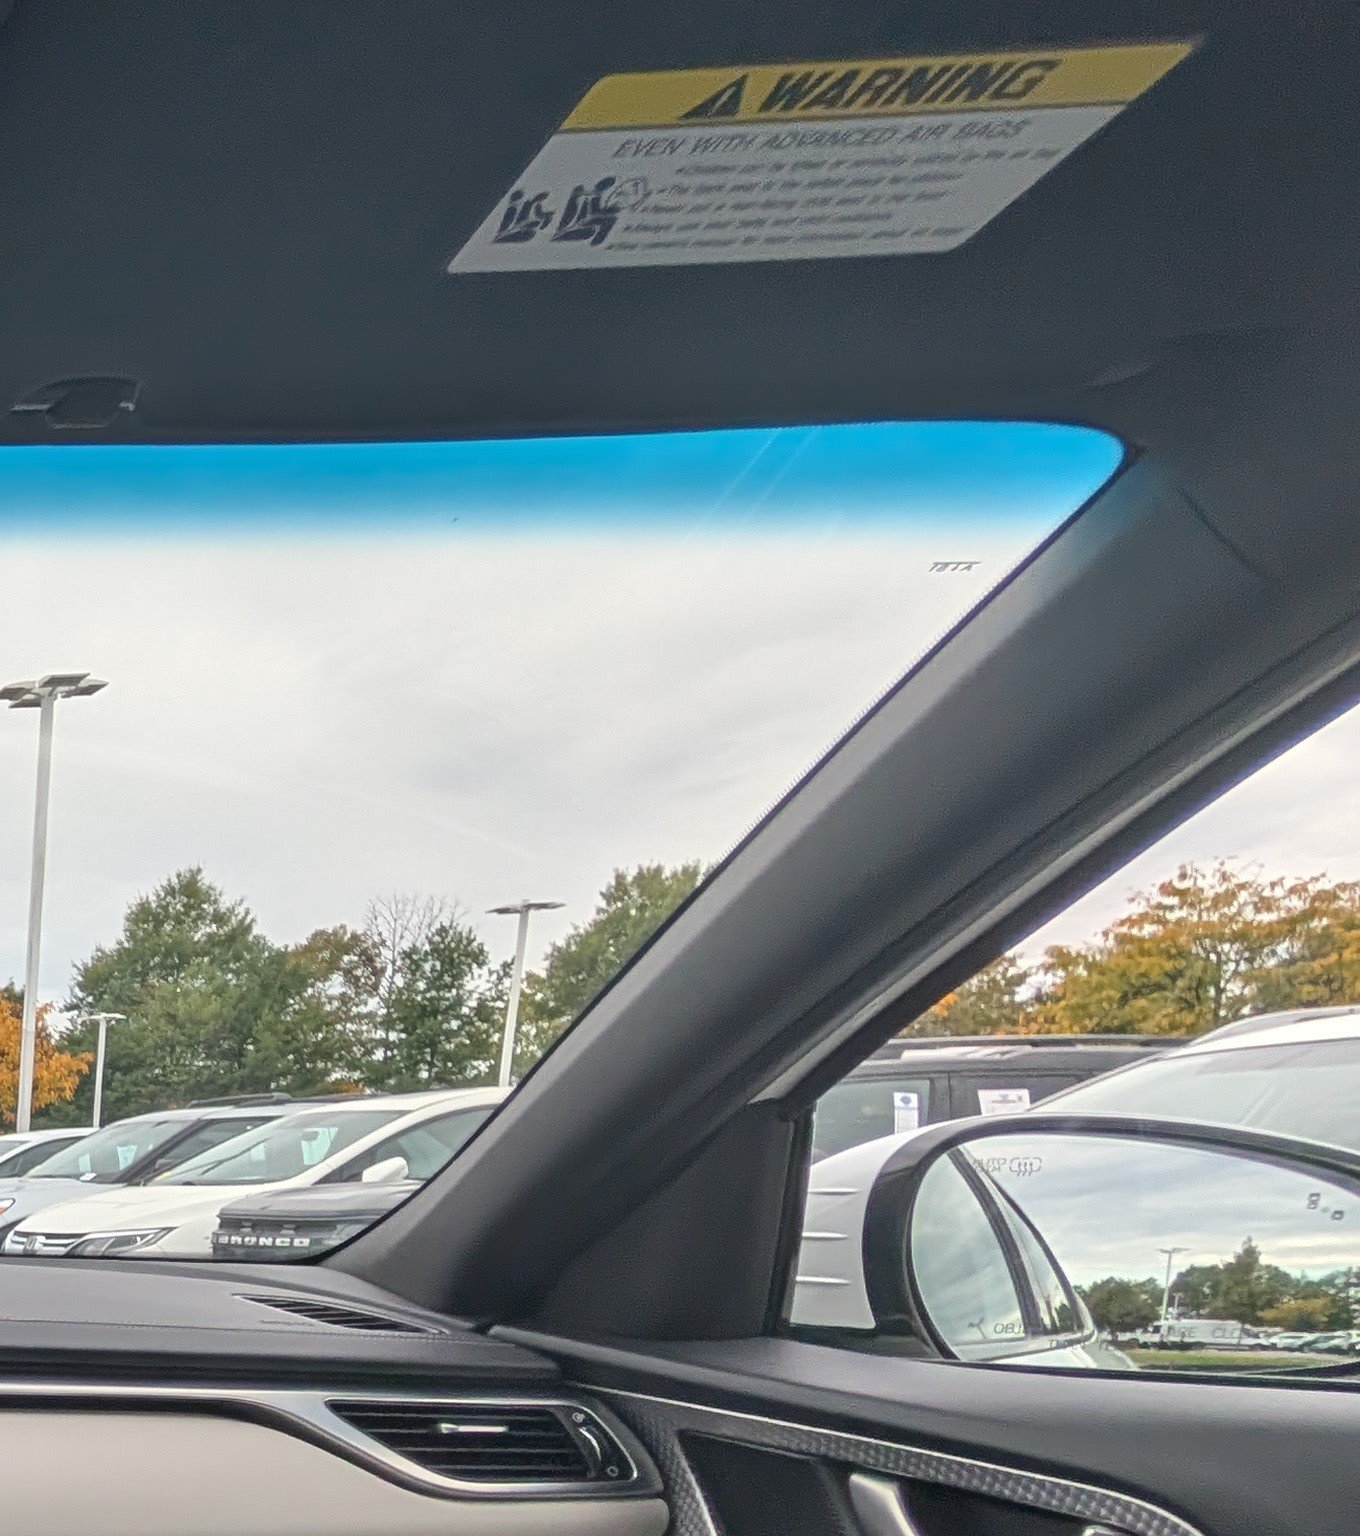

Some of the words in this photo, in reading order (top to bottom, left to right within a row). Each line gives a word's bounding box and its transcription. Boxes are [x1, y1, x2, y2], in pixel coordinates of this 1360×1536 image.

[757, 59, 1062, 112] WARNING
[613, 136, 684, 158] EVEN
[686, 132, 759, 155] WITH
[765, 126, 899, 151] ADVANCED
[897, 121, 953, 146] AIR
[953, 117, 1031, 140] BAGS
[219, 1235, 311, 1247] BRONCO
